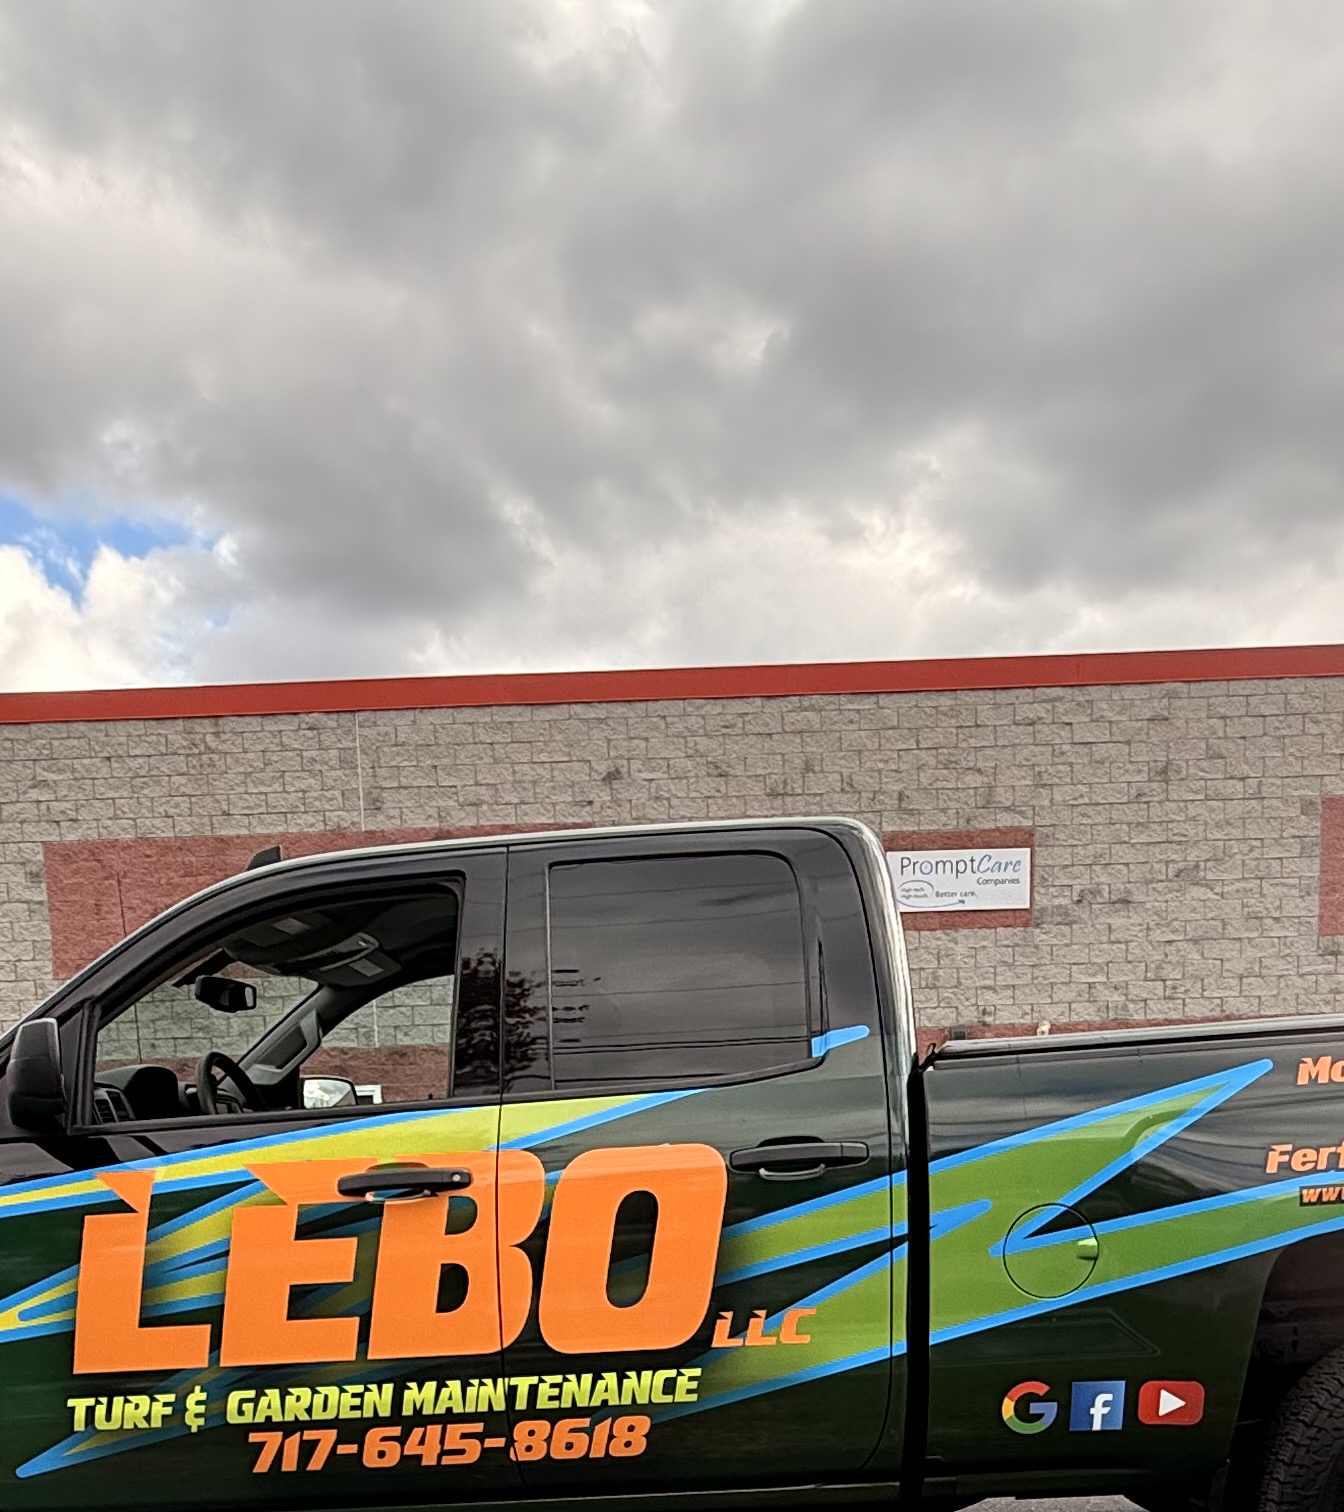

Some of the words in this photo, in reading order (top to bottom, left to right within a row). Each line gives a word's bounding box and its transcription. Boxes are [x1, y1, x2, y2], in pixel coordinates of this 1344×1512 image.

[900, 853, 1022, 879] PromptCare
[976, 876, 1020, 886] Companies
[935, 890, 957, 898] Better
[72, 1143, 728, 1375] LEBO
[710, 1308, 817, 1348] LLC
[66, 1393, 176, 1432] TURF
[184, 1385, 208, 1433] &
[225, 1383, 394, 1424] GARDEN
[401, 1368, 703, 1416] MAINTENANCE
[1001, 1380, 1058, 1435] G
[247, 1415, 652, 1474] 717-645-8618
